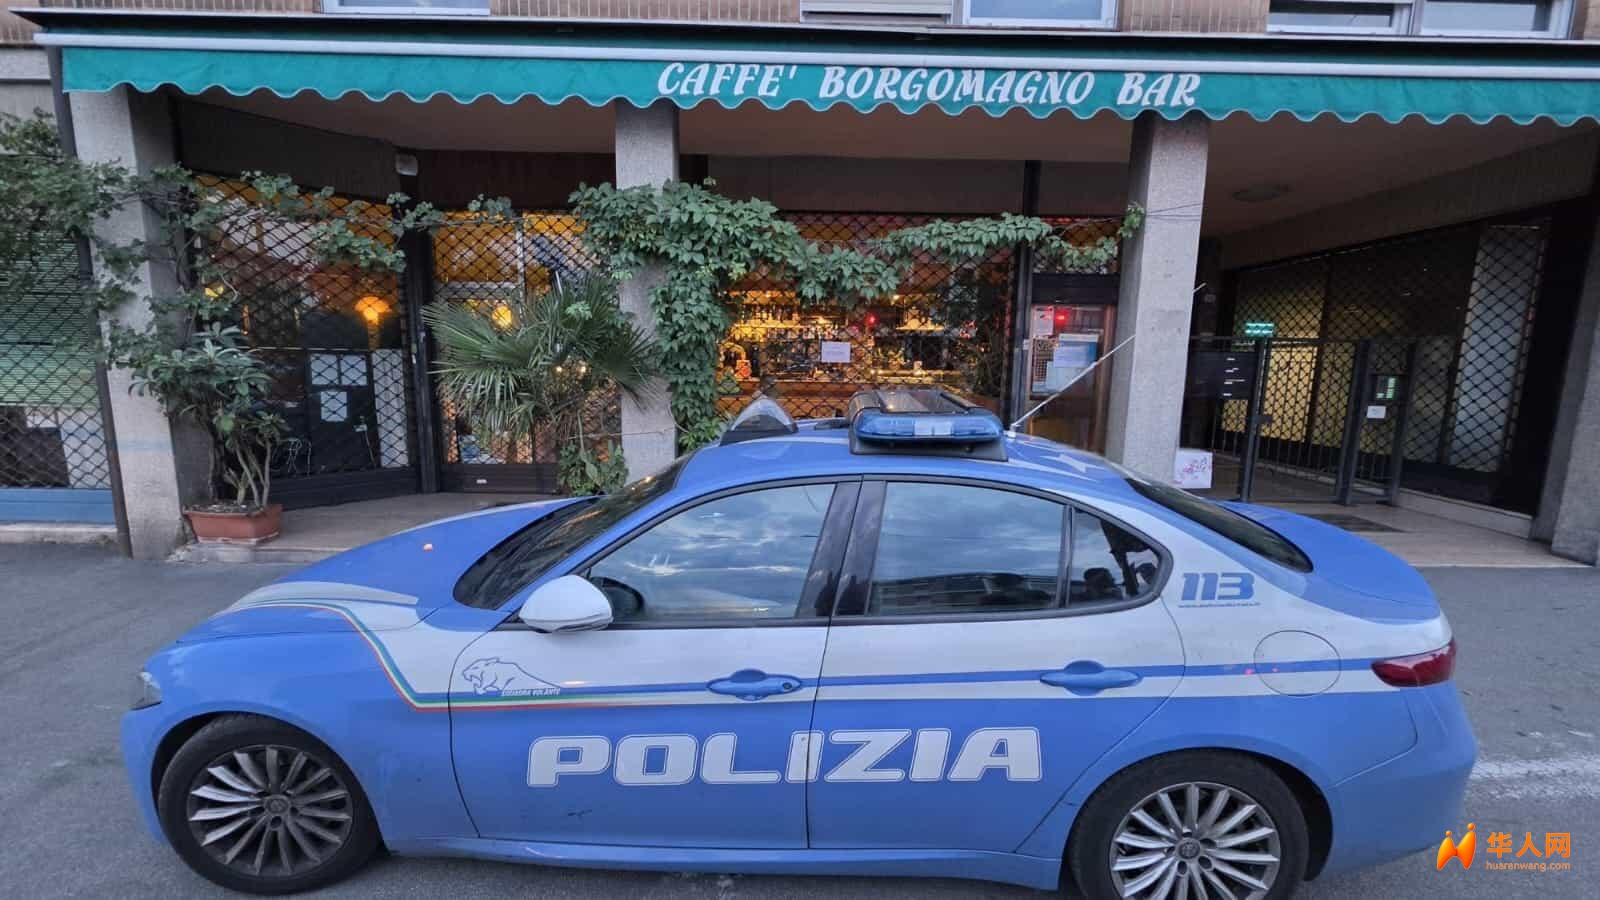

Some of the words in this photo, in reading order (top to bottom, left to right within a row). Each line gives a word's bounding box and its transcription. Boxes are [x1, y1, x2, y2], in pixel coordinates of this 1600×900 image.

[657, 62, 797, 97] CAFFE'
[818, 66, 1095, 105] BORGOMAGNO
[1116, 72, 1200, 106] BAR
[1181, 572, 1255, 601] 113
[527, 727, 1042, 787] POLIZIA
